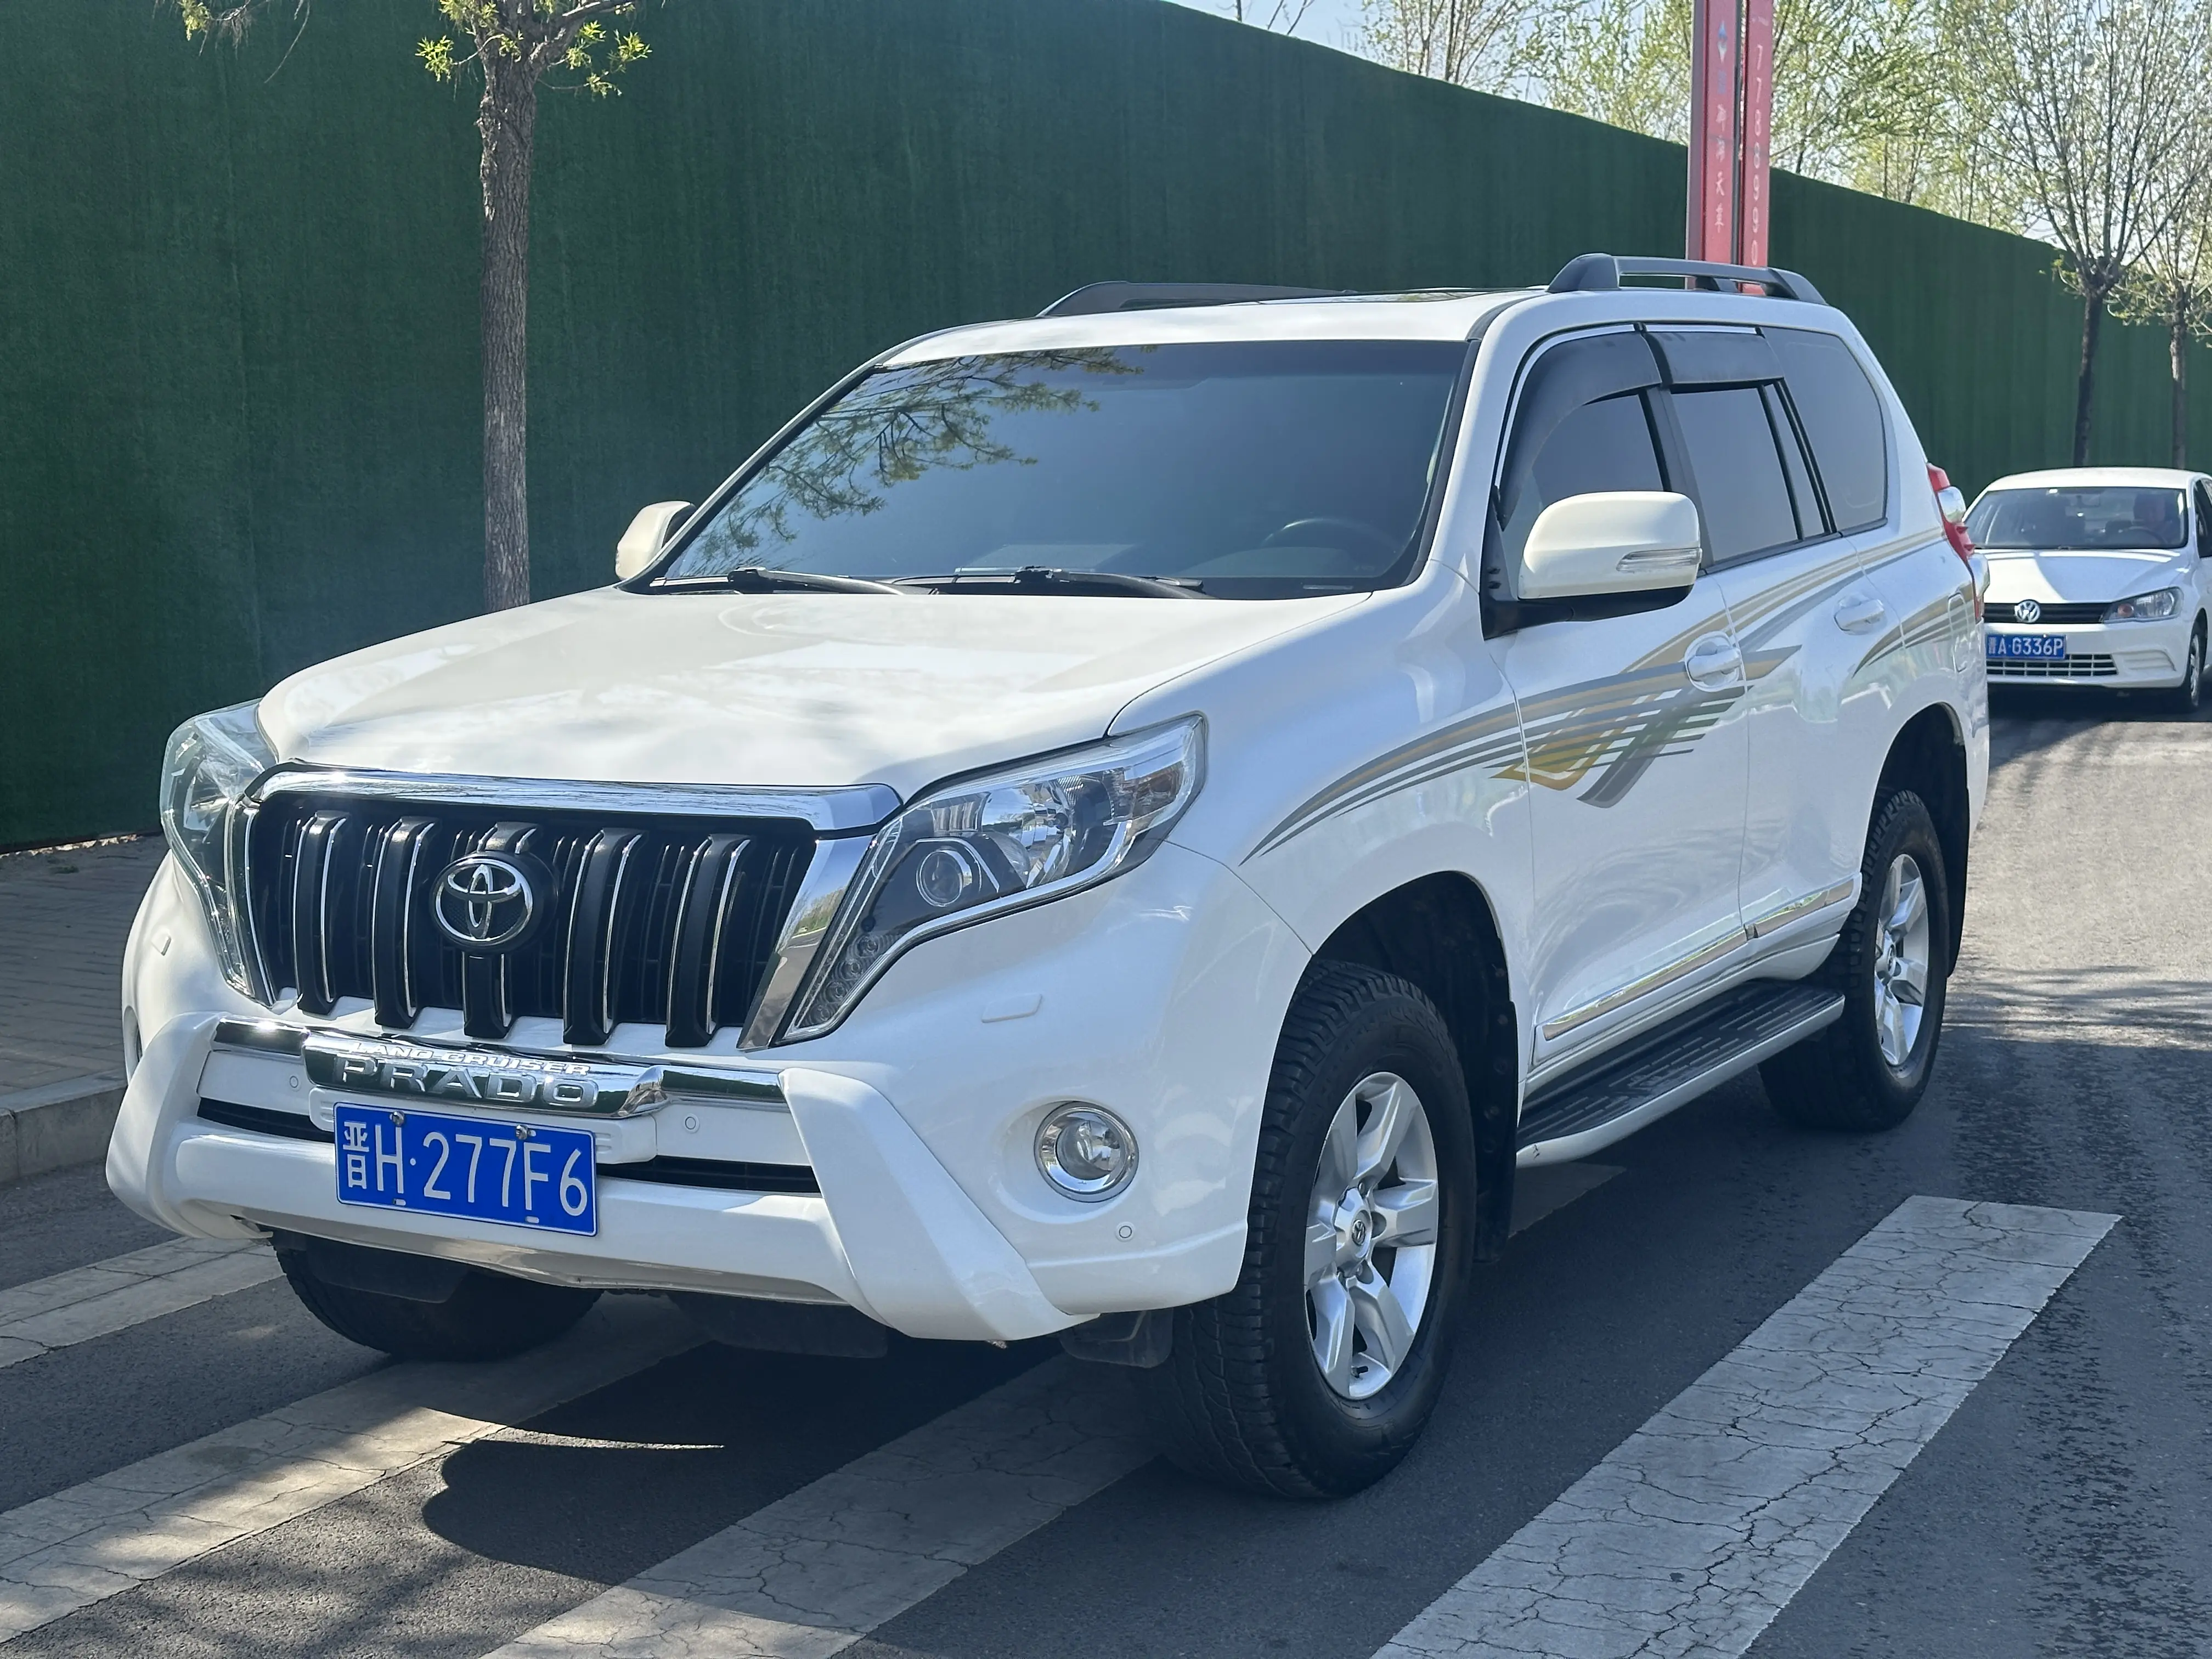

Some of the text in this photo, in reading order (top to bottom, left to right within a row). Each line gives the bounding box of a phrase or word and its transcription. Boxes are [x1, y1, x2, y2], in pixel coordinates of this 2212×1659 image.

[334, 1052, 599, 1108] PRADO
[349, 1042, 591, 1076] LAND CRUISER
